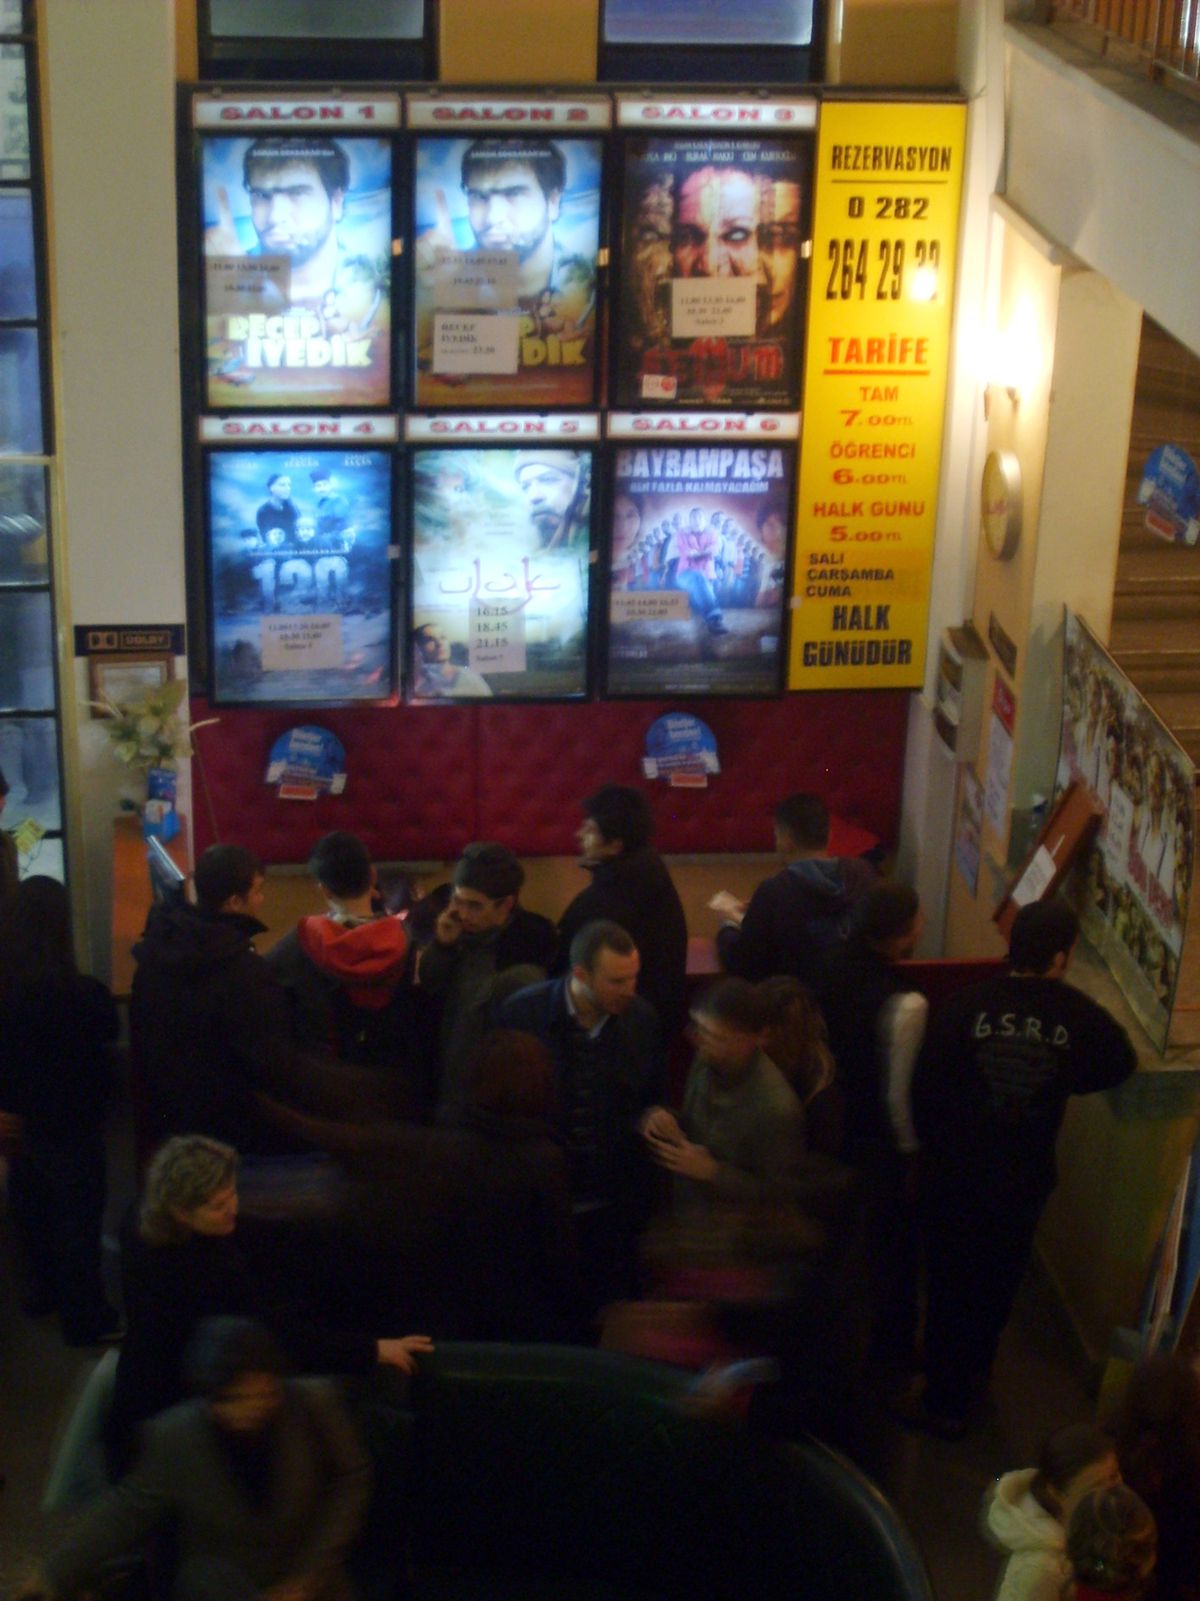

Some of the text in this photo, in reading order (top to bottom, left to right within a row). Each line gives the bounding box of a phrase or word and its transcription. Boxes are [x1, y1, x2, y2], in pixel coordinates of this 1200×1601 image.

[220, 106, 375, 120] SALON 1
[432, 107, 588, 121] SALON 2
[641, 106, 795, 121] SALON 3
[832, 145, 951, 171] REZERVASYON
[848, 196, 930, 220] 0 282
[826, 239, 869, 300] 264
[876, 239, 905, 300] 29
[228, 313, 320, 340] RECEP
[828, 333, 929, 364] TARİFE
[860, 386, 899, 402] TAM
[222, 422, 374, 434] SALON 4
[430, 420, 579, 433] SALON 5
[632, 418, 780, 432] SALON 6
[813, 502, 863, 517] HALK
[809, 553, 844, 565] SALI
[252, 556, 350, 606] 120
[806, 585, 852, 597] CUMA
[476, 607, 509, 617] 16.15
[832, 605, 891, 631] HALK
[476, 622, 508, 632] 18.45
[475, 638, 509, 648] 21.15
[803, 639, 912, 667] GÜNÜDÜR
